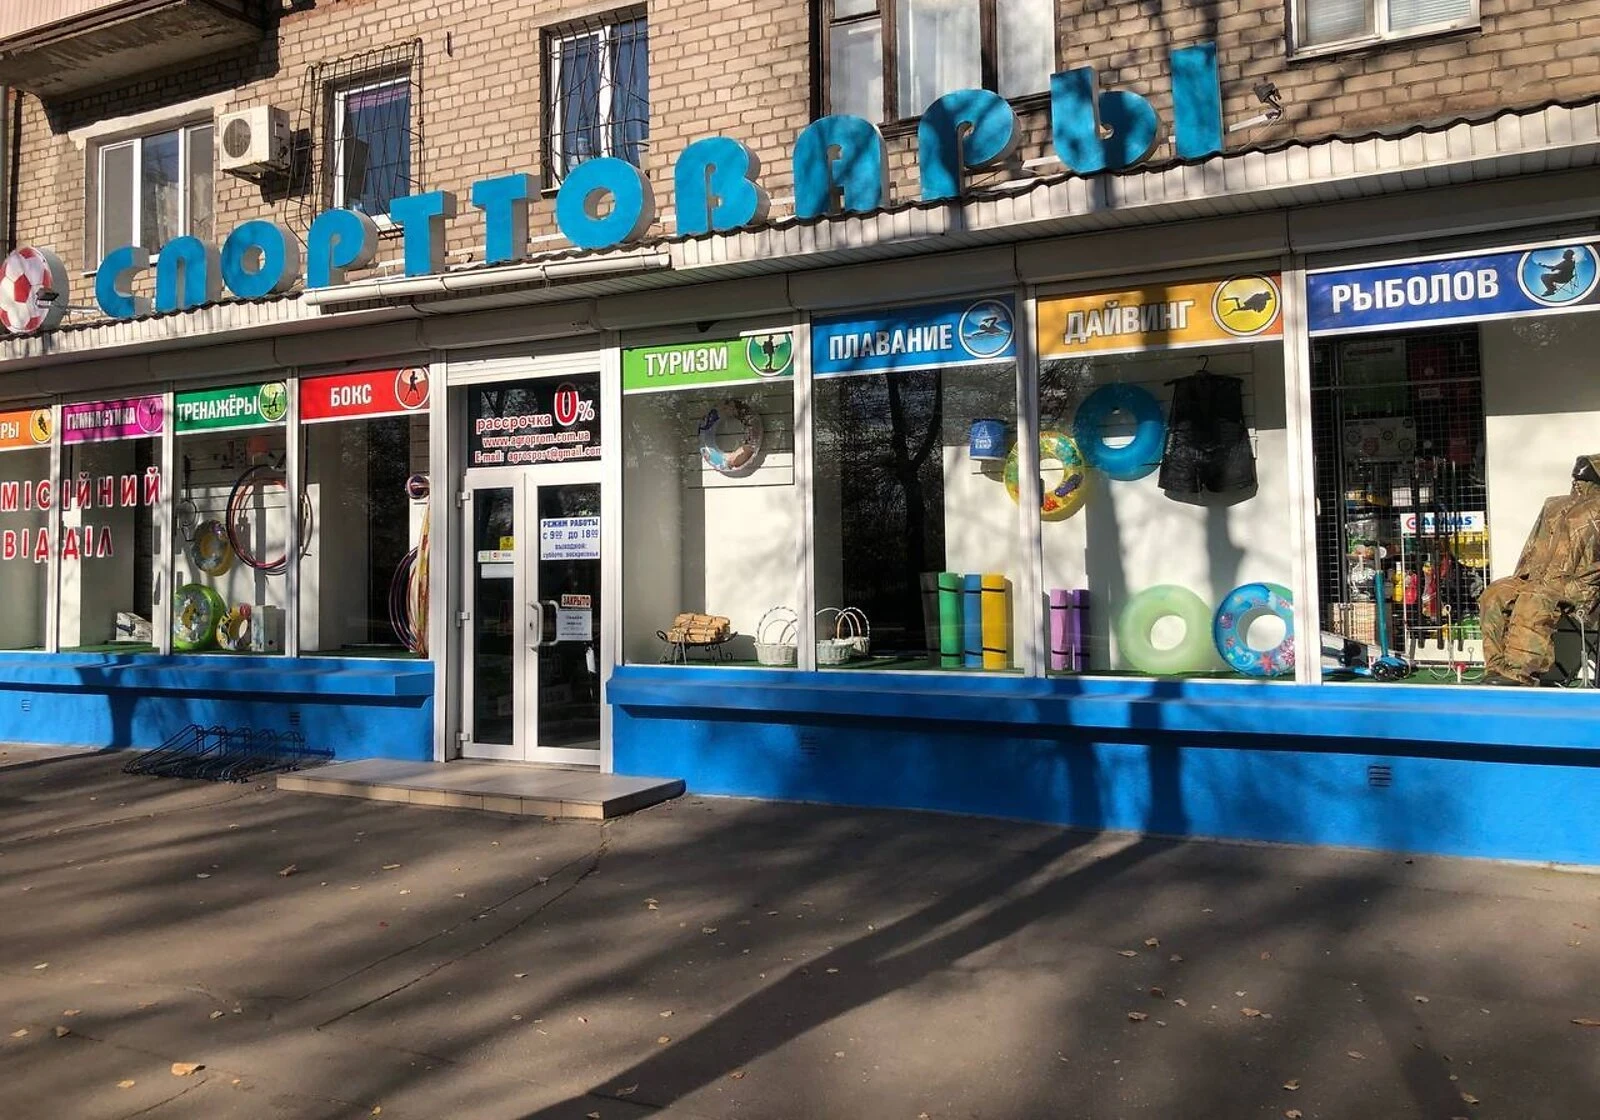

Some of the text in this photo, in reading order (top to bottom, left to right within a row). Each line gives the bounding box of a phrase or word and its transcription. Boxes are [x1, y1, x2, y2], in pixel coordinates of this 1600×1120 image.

[95, 42, 1225, 319] СПОРТТОВАРЫ
[1332, 268, 1499, 314] РЫБОЛОВ
[1063, 299, 1196, 345] ДАЙВИНГ
[828, 323, 954, 362] ПЛАВАНИЕ
[644, 345, 729, 377] ТУРИЗМ
[177, 394, 259, 422] ТРЕНАЖЁРЫ
[330, 383, 373, 408] БОКС
[475, 383, 596, 435] рассрочка 0%
[66, 406, 136, 430] ГИМНАСТИКА
[482, 430, 591, 449] www.agroprom.com.ua
[474, 450, 505, 464] E-mail:
[570, 518, 599, 527] РАБОТЫ
[2, 525, 114, 564] ВІДДІЛ
